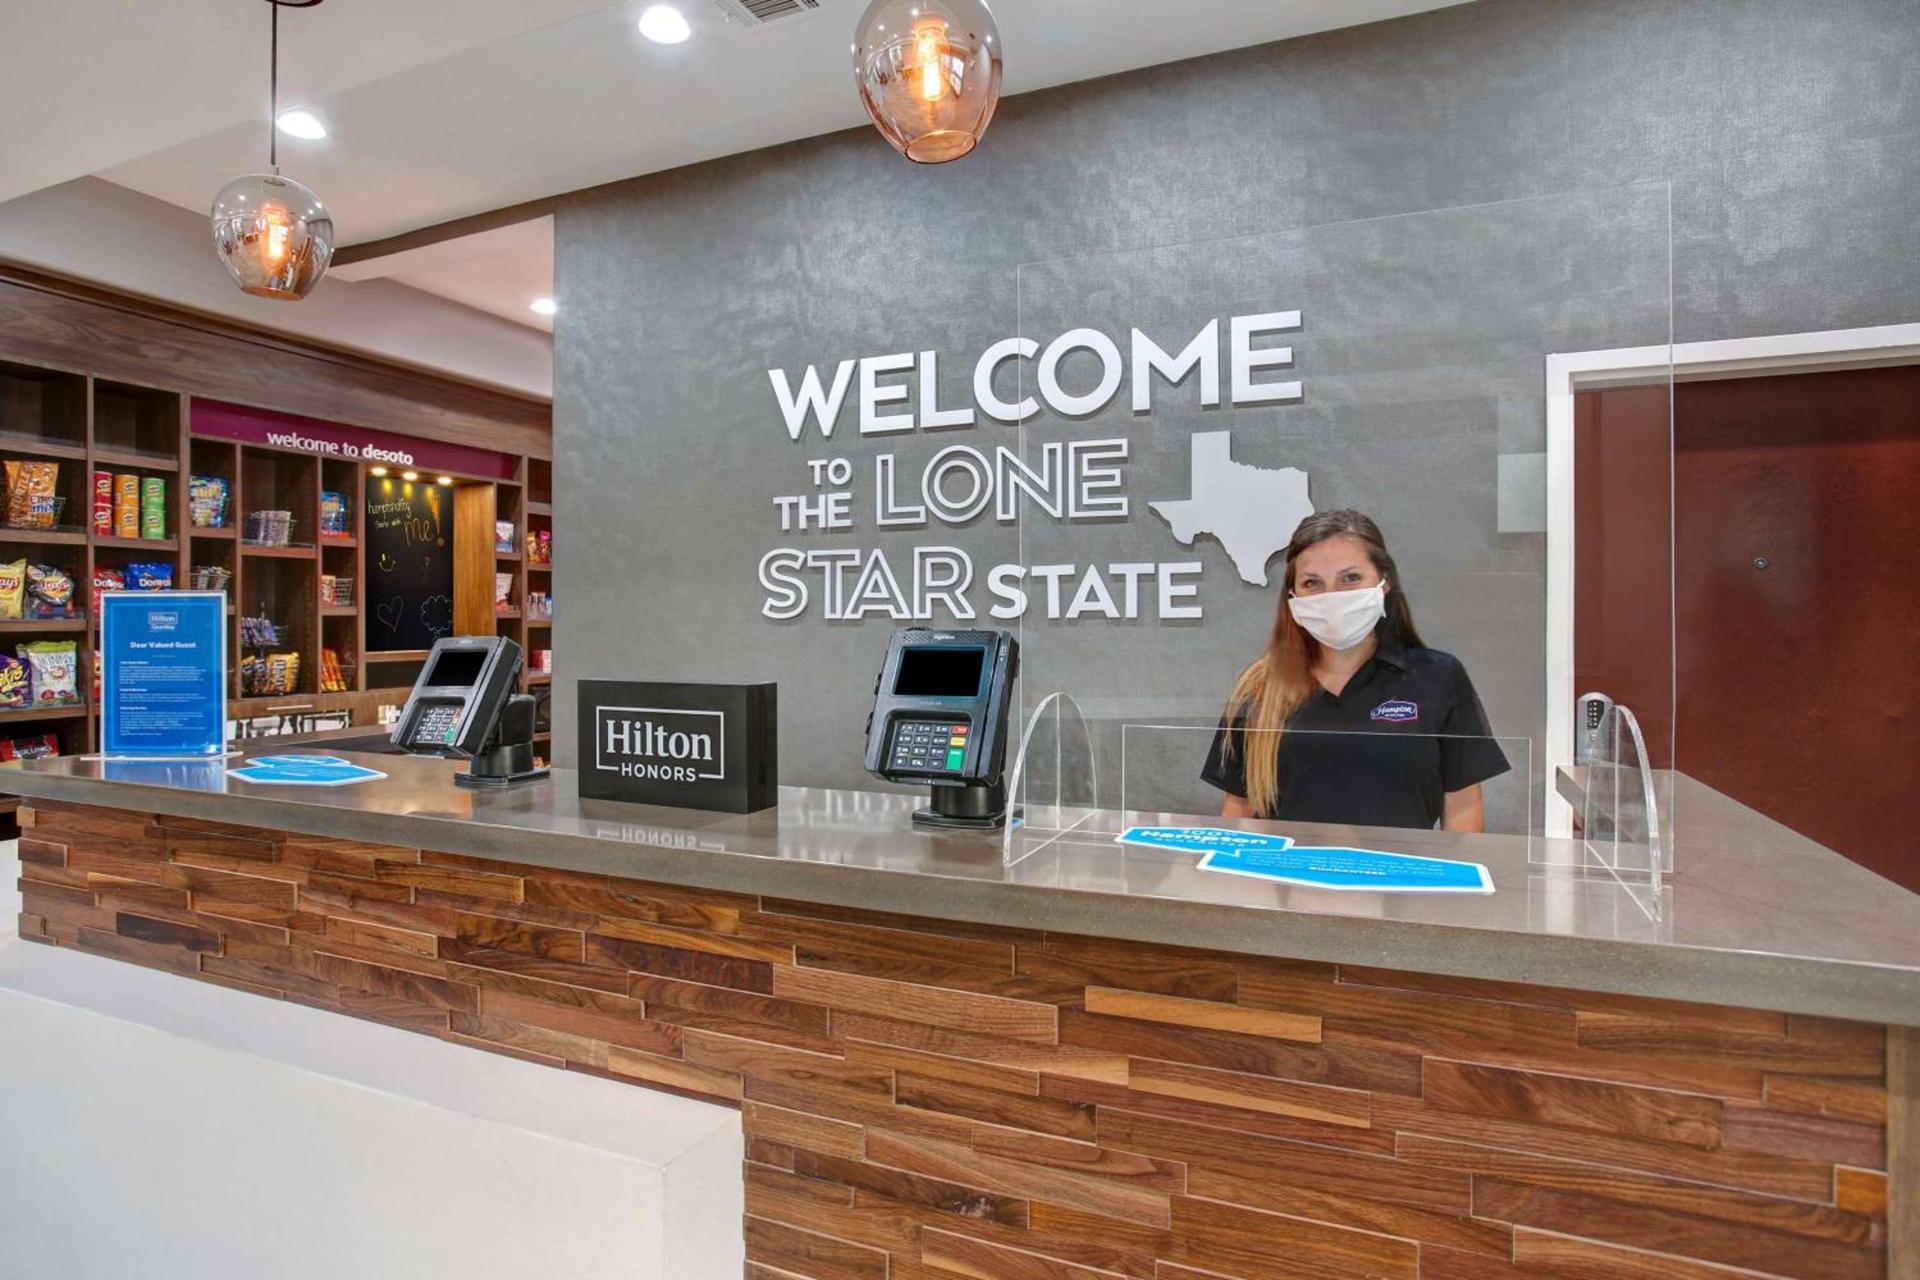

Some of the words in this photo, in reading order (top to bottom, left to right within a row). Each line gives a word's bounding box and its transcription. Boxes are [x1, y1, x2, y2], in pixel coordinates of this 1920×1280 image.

[768, 310, 1302, 440] WELCOME
[266, 432, 339, 455] welcome
[343, 442, 358, 457] to
[362, 444, 413, 465] desoto
[808, 458, 852, 486] TO
[876, 438, 1128, 526] LONE
[773, 492, 853, 530] THE
[758, 546, 976, 620] STAR
[986, 562, 1203, 619] STATE
[606, 719, 712, 760] Hilton
[621, 762, 696, 782] HONORS
[1140, 830, 1268, 845] Hampton
